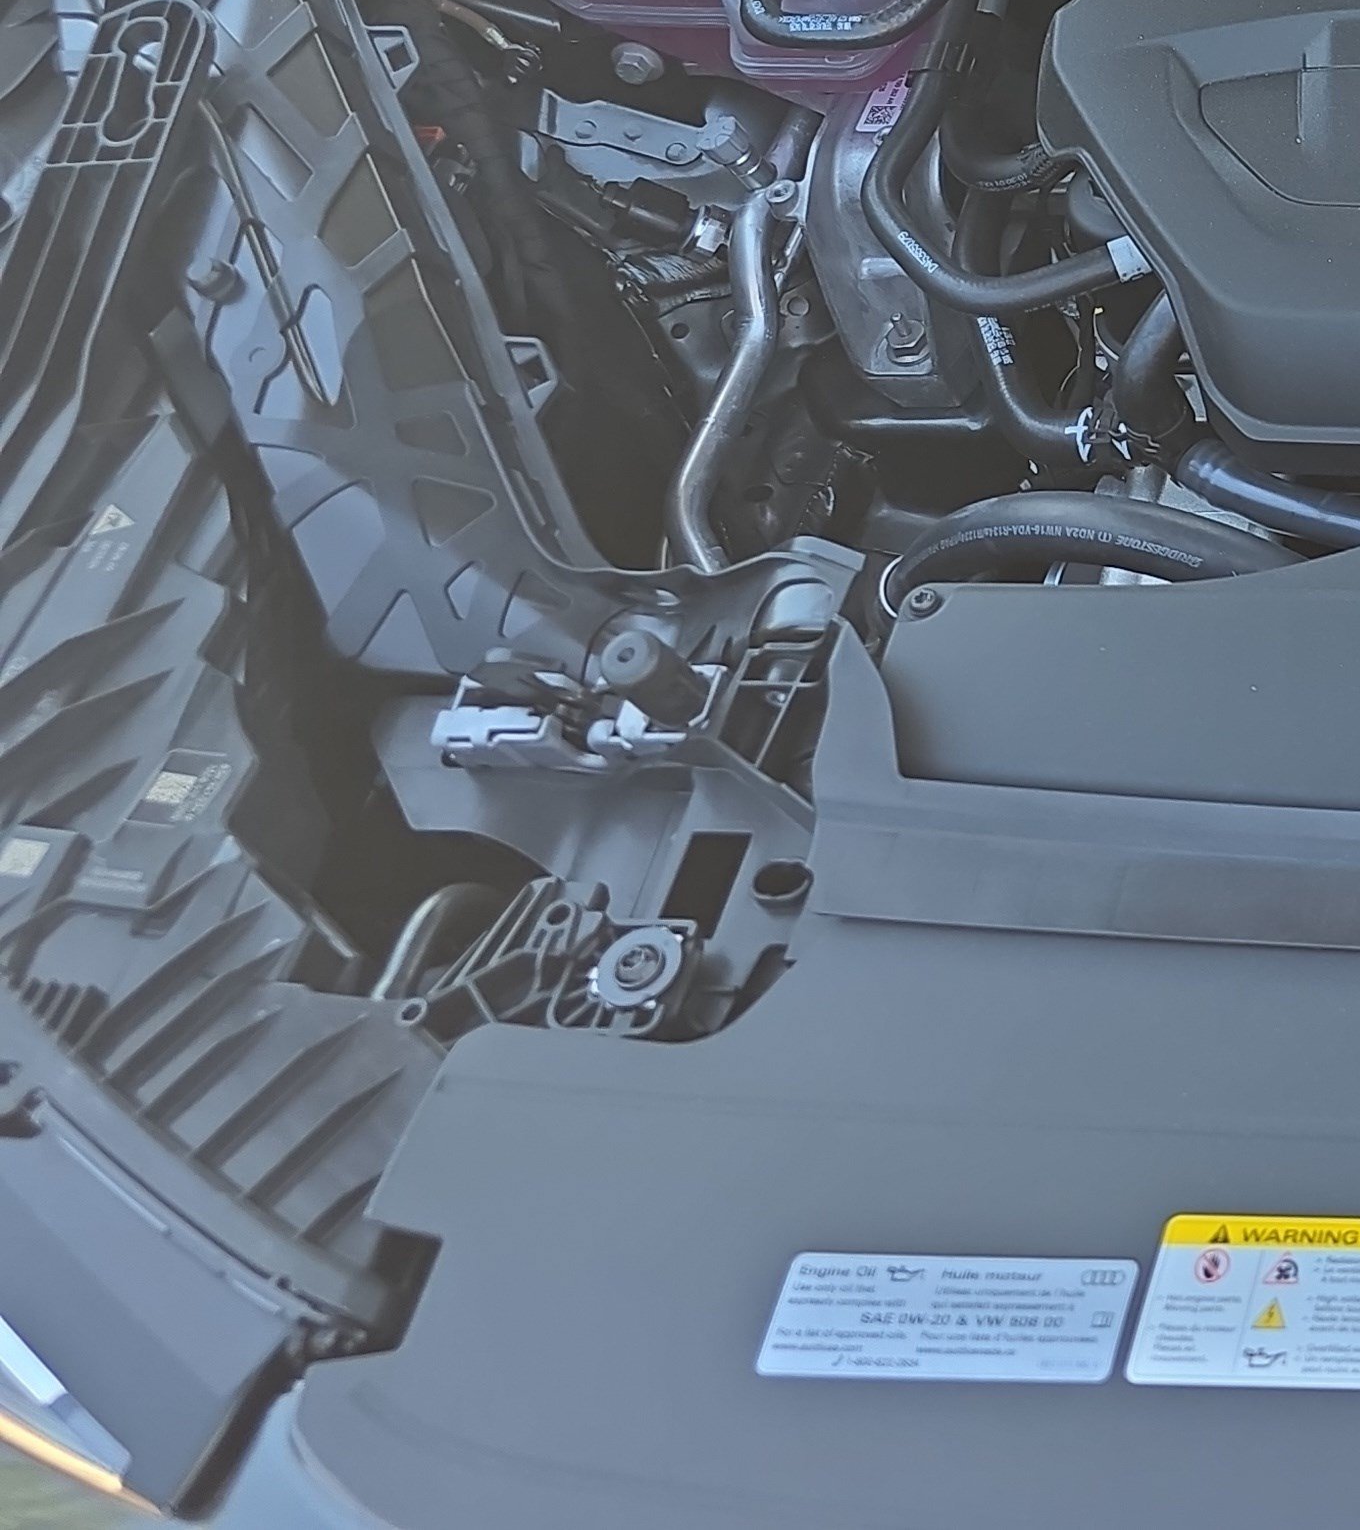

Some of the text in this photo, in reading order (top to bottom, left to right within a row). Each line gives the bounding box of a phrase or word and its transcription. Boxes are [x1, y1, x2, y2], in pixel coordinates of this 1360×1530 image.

[1243, 1227, 1360, 1245] WARNING
[799, 1264, 877, 1278] Engine Oil
[941, 1268, 979, 1281] Huile
[860, 1311, 894, 1324] SAE
[898, 1312, 951, 1325] 0W-20
[956, 1315, 968, 1326] &
[976, 1315, 1004, 1327] VW
